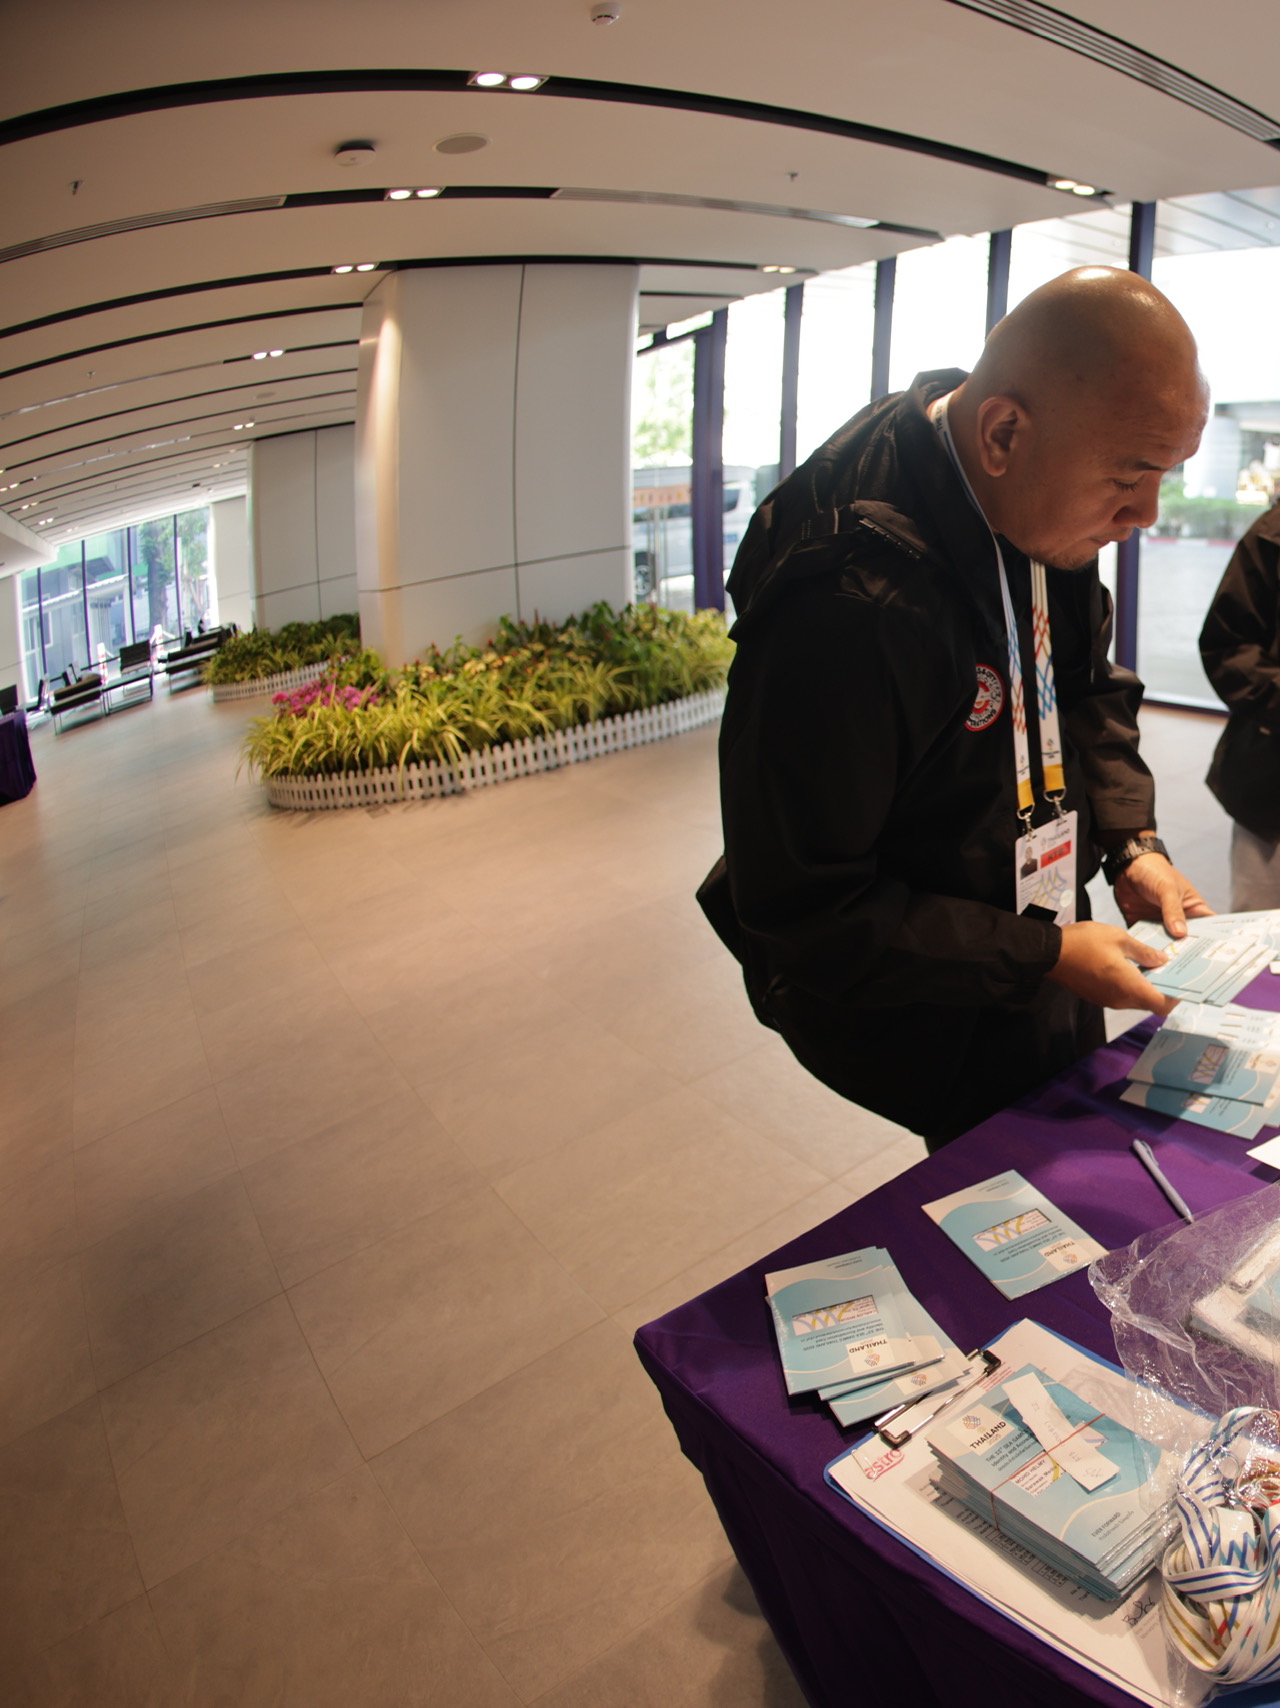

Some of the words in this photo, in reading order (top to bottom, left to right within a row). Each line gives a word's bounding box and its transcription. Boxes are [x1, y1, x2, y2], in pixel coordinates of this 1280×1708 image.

[1044, 1241, 1076, 1257] THAILAND
[848, 1339, 888, 1353] THAILAND
[969, 1421, 1007, 1449] THAILAND
[865, 1449, 903, 1480] astro
